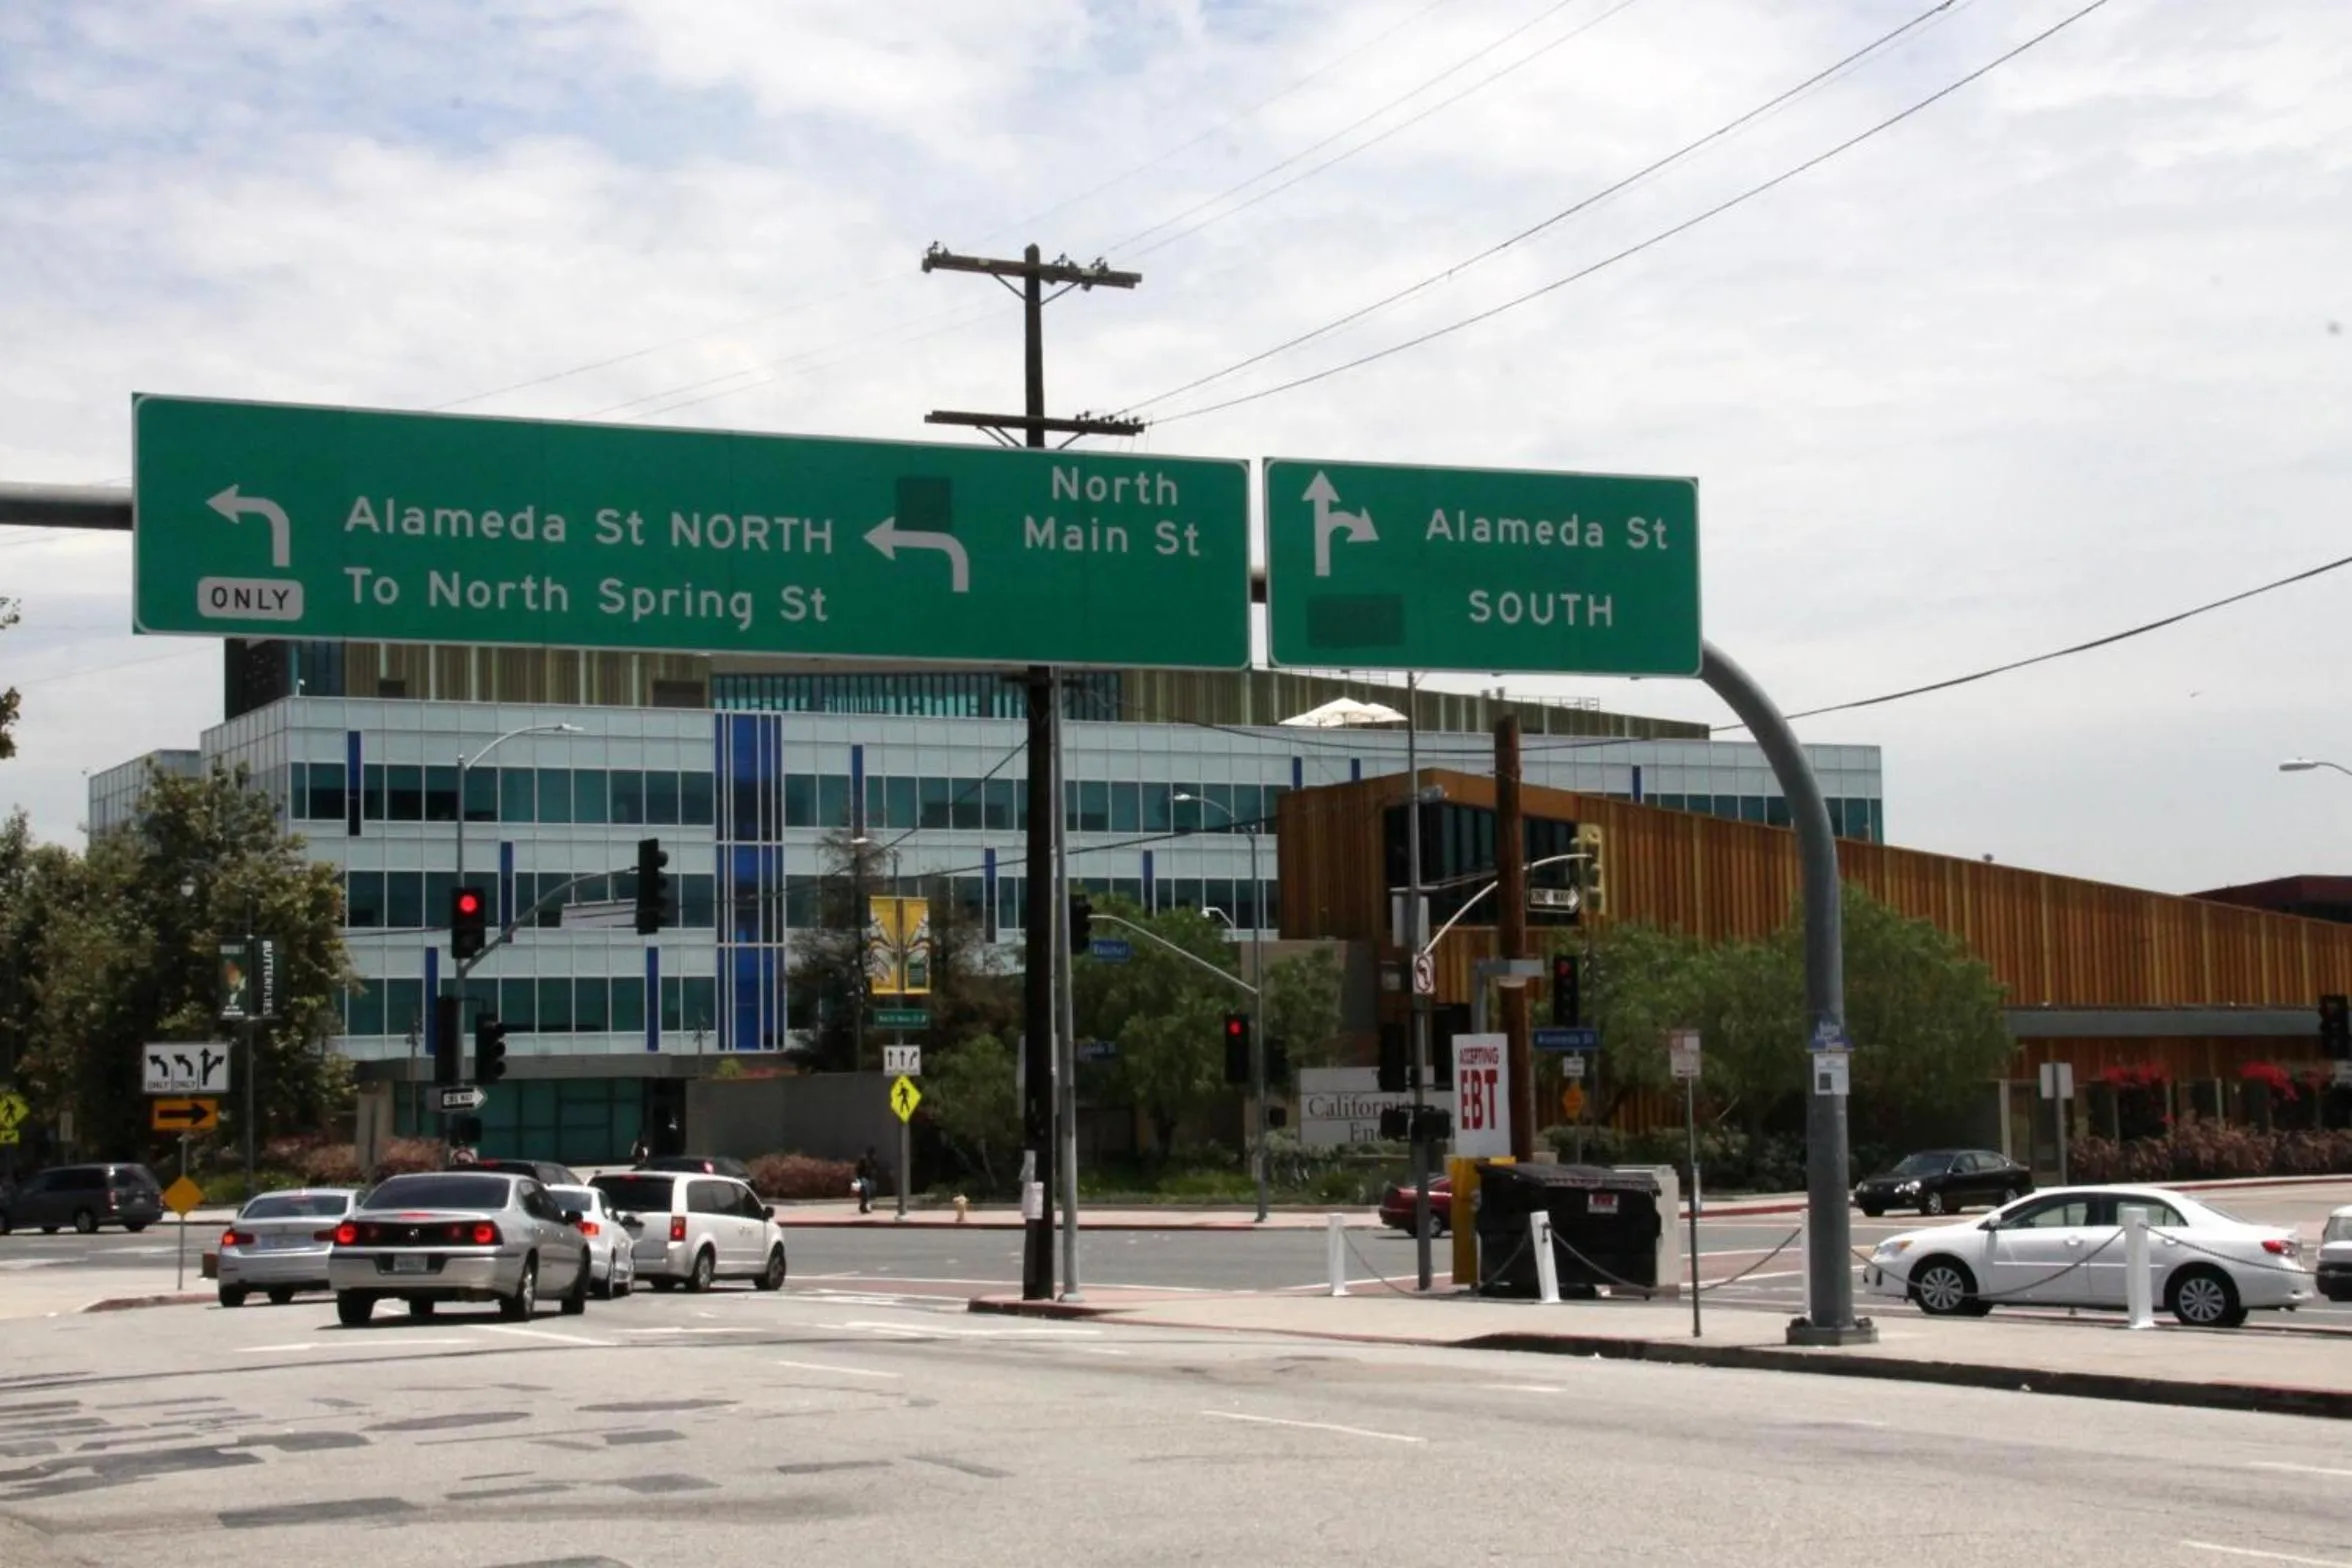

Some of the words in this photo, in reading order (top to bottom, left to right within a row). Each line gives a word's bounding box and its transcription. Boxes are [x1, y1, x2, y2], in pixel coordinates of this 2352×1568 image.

[1051, 465, 1178, 505] North
[344, 495, 566, 543] Alameda
[595, 508, 645, 546] St
[670, 511, 833, 555] NORTH
[1024, 515, 1128, 553] Main
[1154, 519, 1200, 557] St
[1425, 507, 1604, 548] Alameda
[1627, 516, 1668, 550] St
[210, 586, 290, 611] ONLY
[343, 566, 400, 605] To
[428, 569, 569, 612] North
[598, 577, 753, 632] Spring
[780, 585, 828, 622] St
[1468, 589, 1613, 627] SOUTH
[263, 940, 273, 1016] BUTTERFLIES
[1459, 1046, 1499, 1065] ACCEPTING
[1460, 1069, 1498, 1130] EBT
